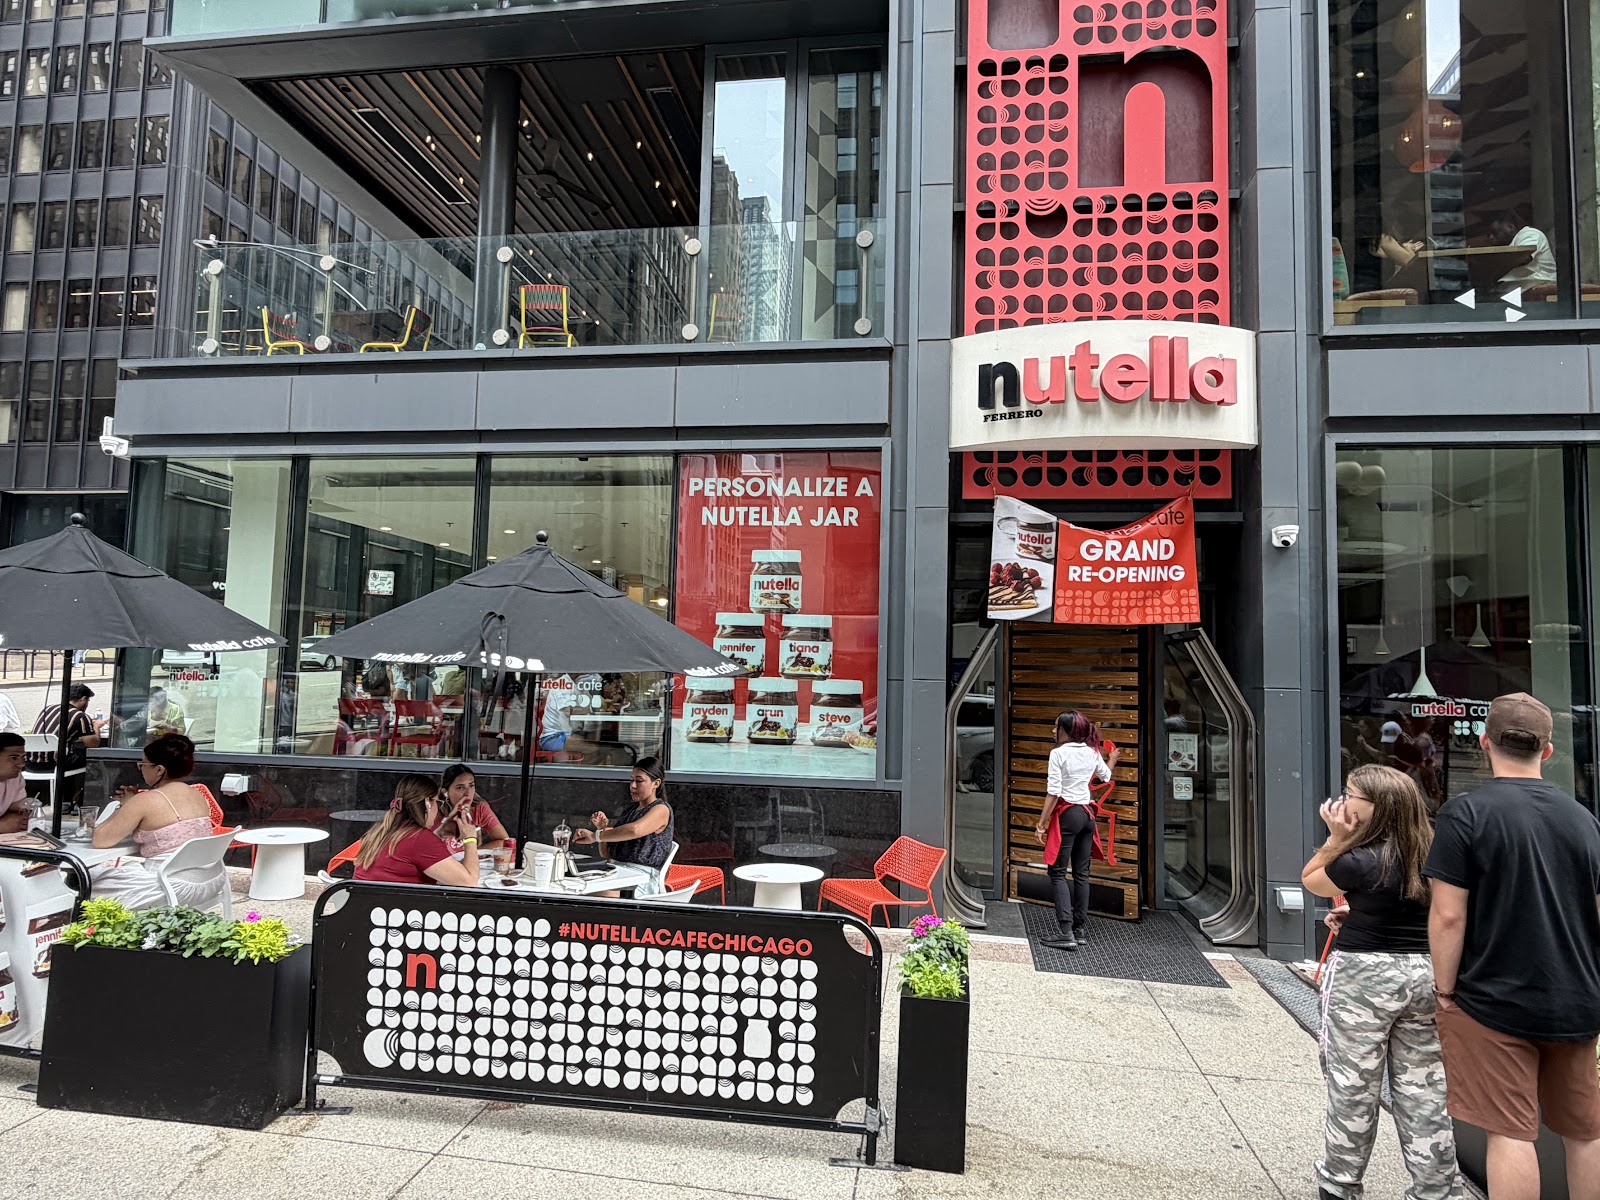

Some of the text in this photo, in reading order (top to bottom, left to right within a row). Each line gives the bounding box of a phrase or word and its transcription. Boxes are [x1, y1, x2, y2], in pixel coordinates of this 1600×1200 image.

[977, 335, 1237, 410] nutella
[983, 409, 1043, 423] FERRERO
[689, 477, 873, 497] PERSONALIZE A
[810, 507, 859, 527] JAR
[1080, 539, 1175, 561] GRAND
[1068, 565, 1185, 583] RE-OPENING
[753, 576, 800, 591] nutella
[242, 636, 276, 648] cafe
[789, 642, 820, 653] tiana
[430, 651, 466, 662] cafe
[168, 670, 206, 682] nutella
[540, 678, 603, 691] utella cafe
[691, 705, 728, 719] jayden
[757, 708, 784, 718] arun
[1411, 702, 1490, 717] nutella ca
[818, 712, 851, 724] steve
[35, 928, 63, 948] jennif
[558, 922, 813, 957] #NUTELLACAFECHICAGO
[405, 953, 437, 989] n
